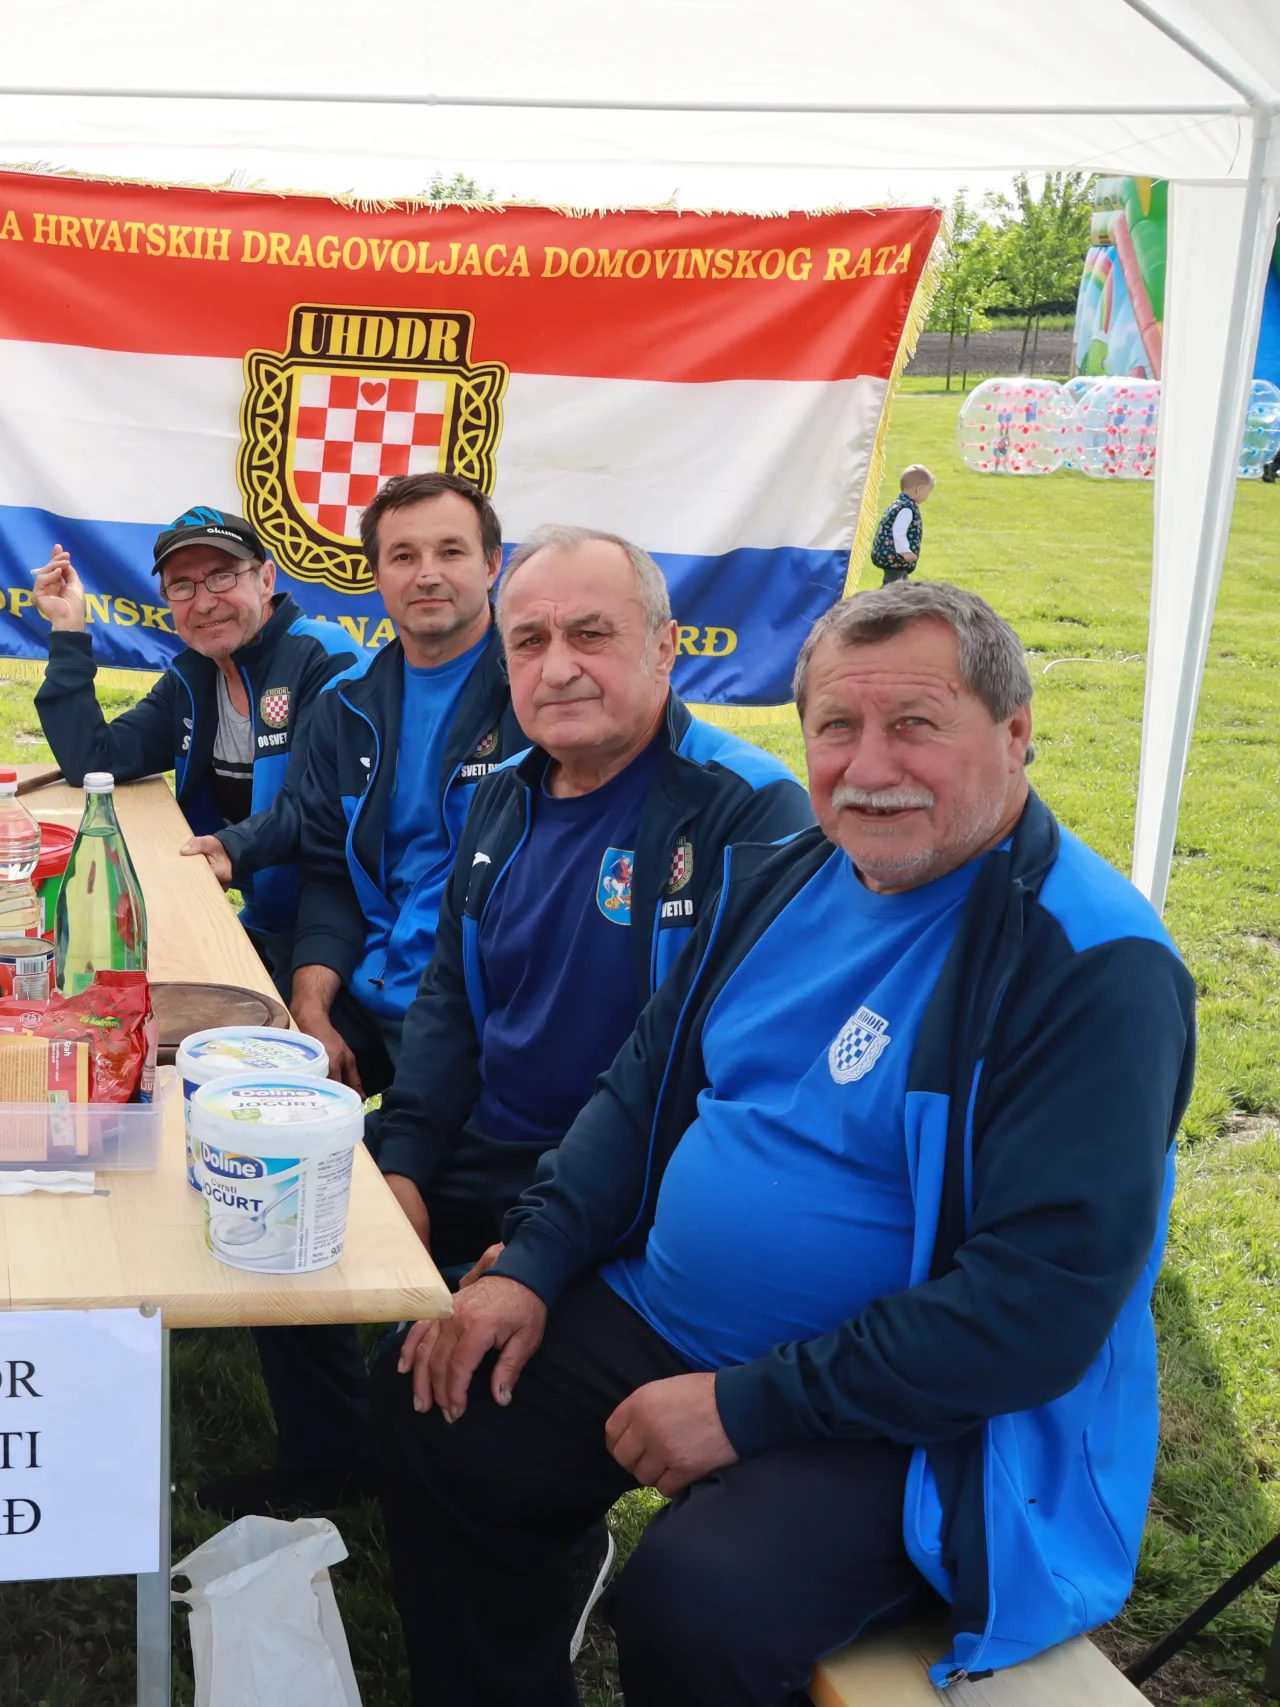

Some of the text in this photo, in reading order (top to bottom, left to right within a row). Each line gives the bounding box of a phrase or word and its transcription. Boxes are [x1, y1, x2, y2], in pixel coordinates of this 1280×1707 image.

[33, 212, 231, 262] HRVATSKIH
[241, 230, 530, 278] DRAGOVOLJACA
[541, 246, 812, 281] DOMOVINSKOG
[823, 242, 912, 281] RATA
[299, 311, 460, 363] UHDDR
[268, 731, 287, 746] SVET
[461, 763, 486, 778] SVETI
[202, 1142, 258, 1178] Doline
